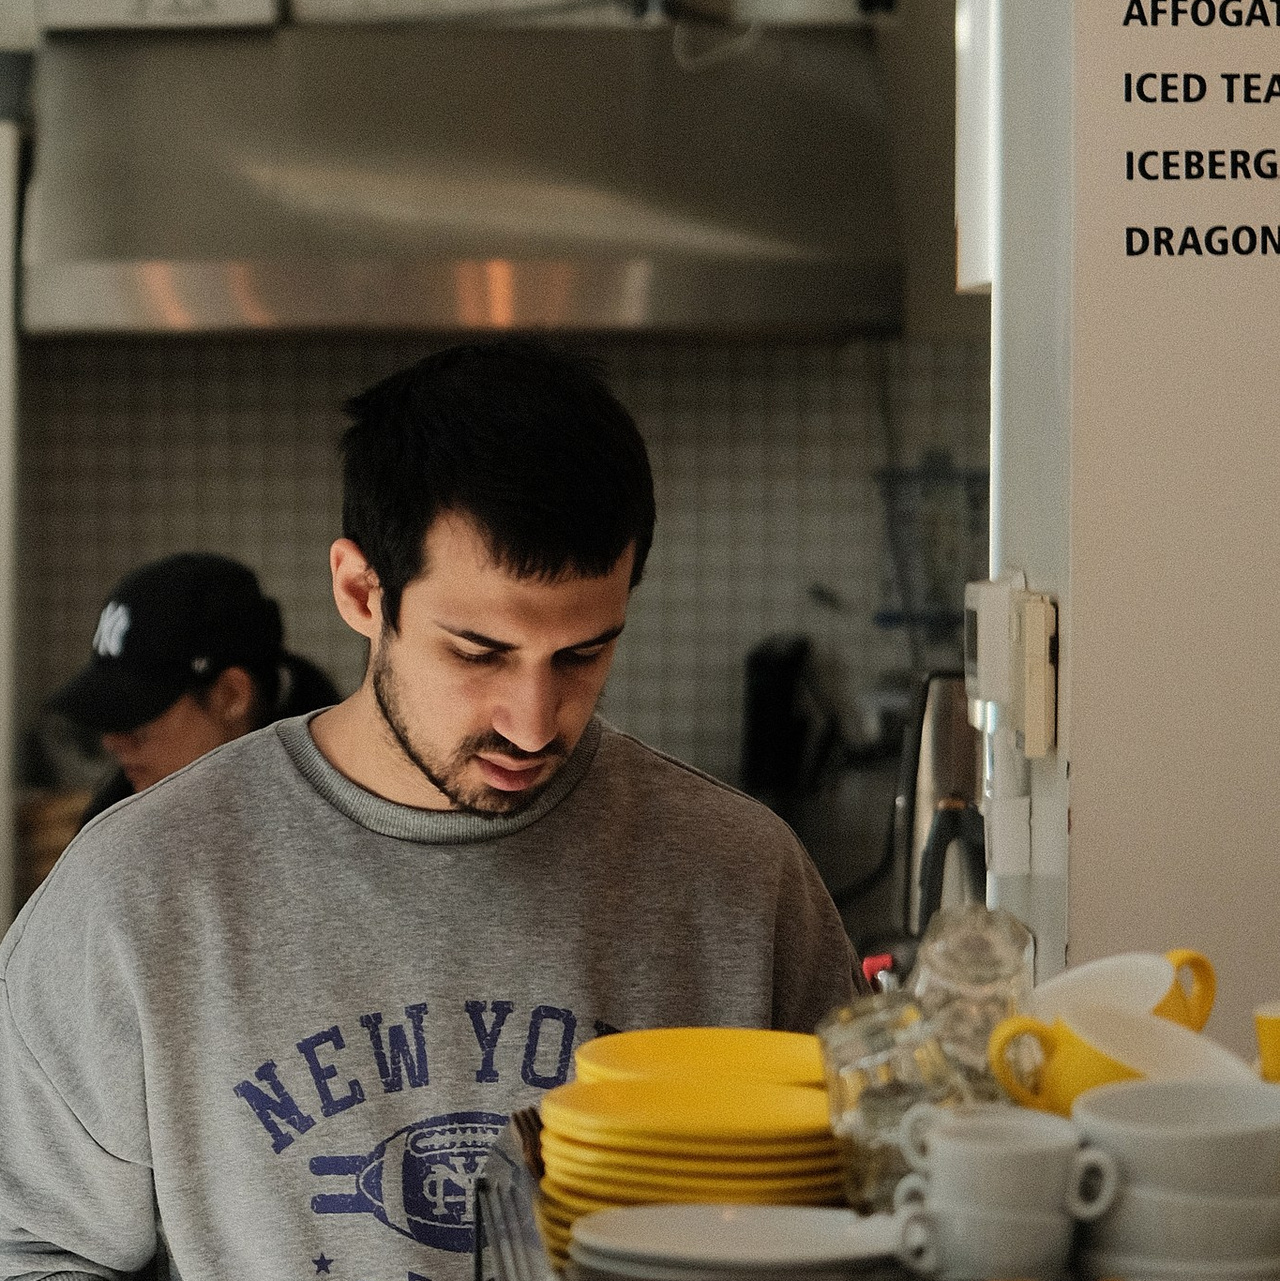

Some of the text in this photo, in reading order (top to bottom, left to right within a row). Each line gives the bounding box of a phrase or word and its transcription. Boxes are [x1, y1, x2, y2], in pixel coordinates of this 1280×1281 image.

[1124, 72, 1280, 104] ICED TEA
[1126, 148, 1279, 181] ICEBERG
[1125, 225, 1280, 257] DRAGON
[233, 1000, 623, 1154] NEW YO
